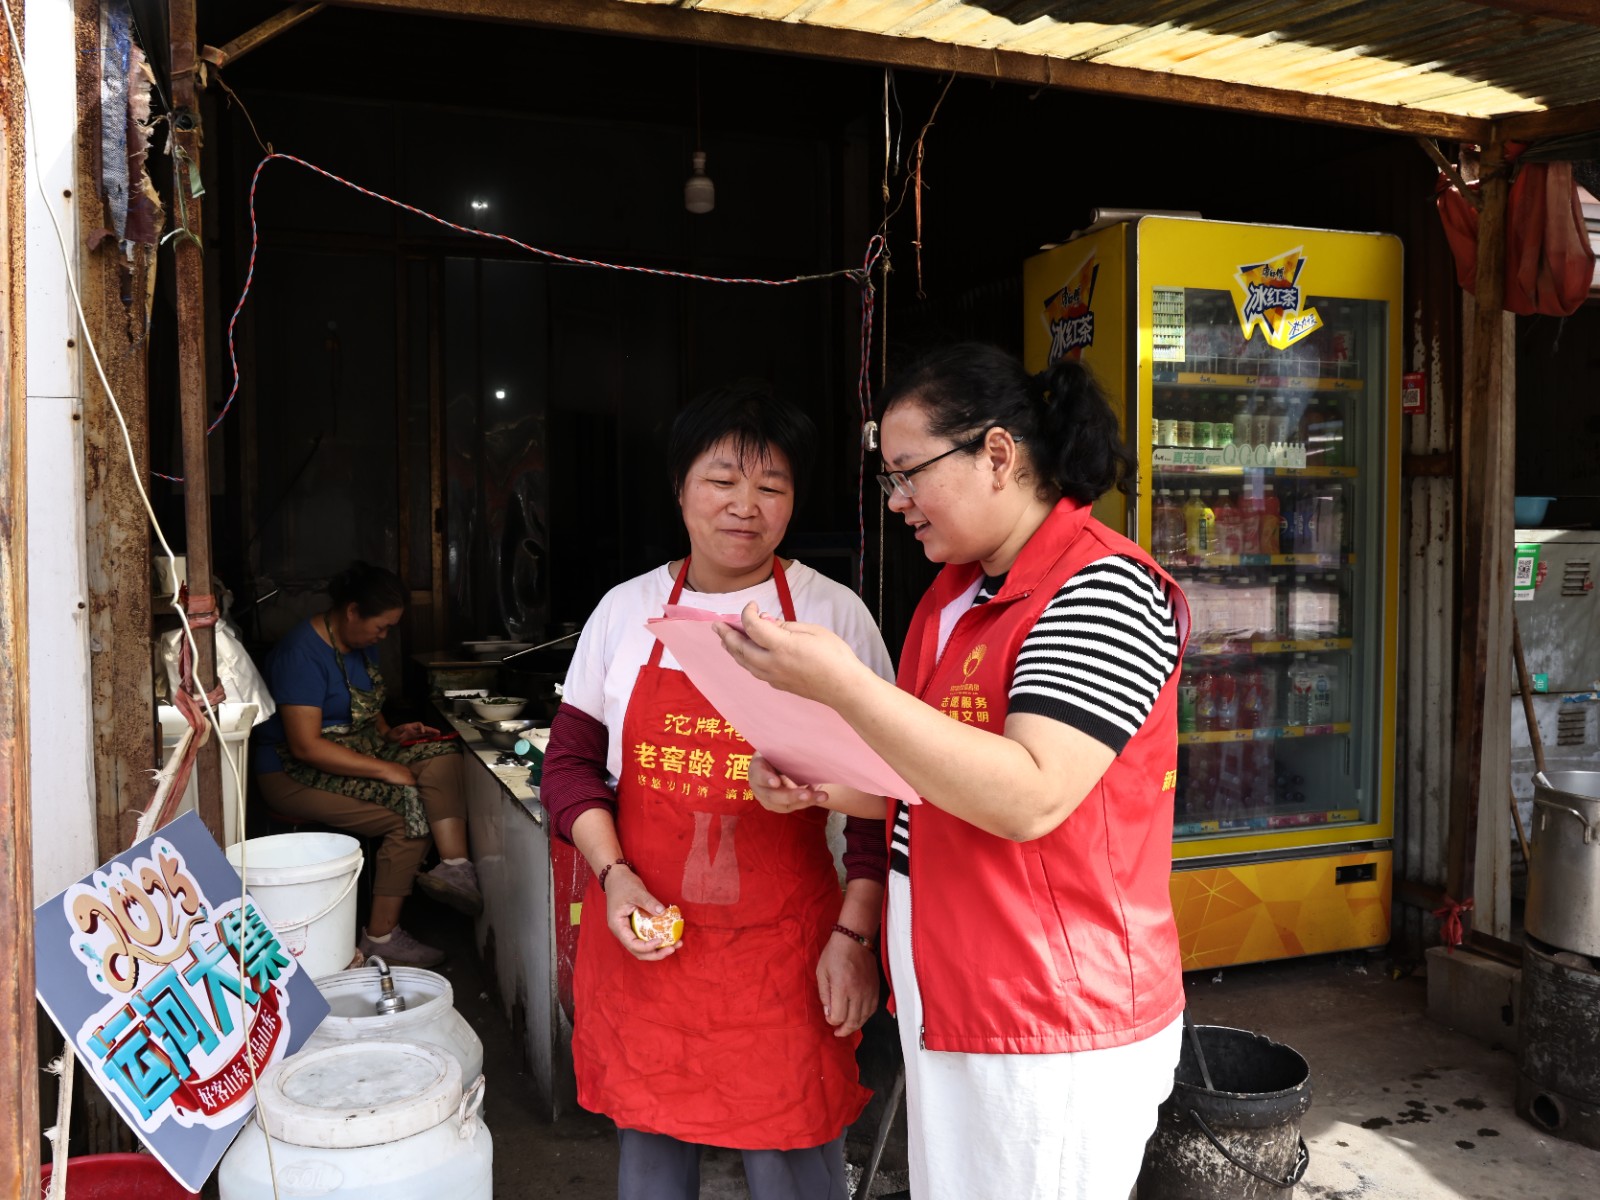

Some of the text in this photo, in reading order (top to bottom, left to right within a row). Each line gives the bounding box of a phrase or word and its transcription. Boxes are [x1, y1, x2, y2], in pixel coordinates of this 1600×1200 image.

[1245, 283, 1298, 316] 冰红茶
[1048, 314, 1093, 367] 冰红茶
[940, 695, 988, 709] 志愿服务
[940, 709, 990, 723] 文明
[633, 741, 753, 781] 老窖龄 酒
[88, 903, 291, 1121] 运河大集
[196, 1062, 251, 1111] 好客山东
